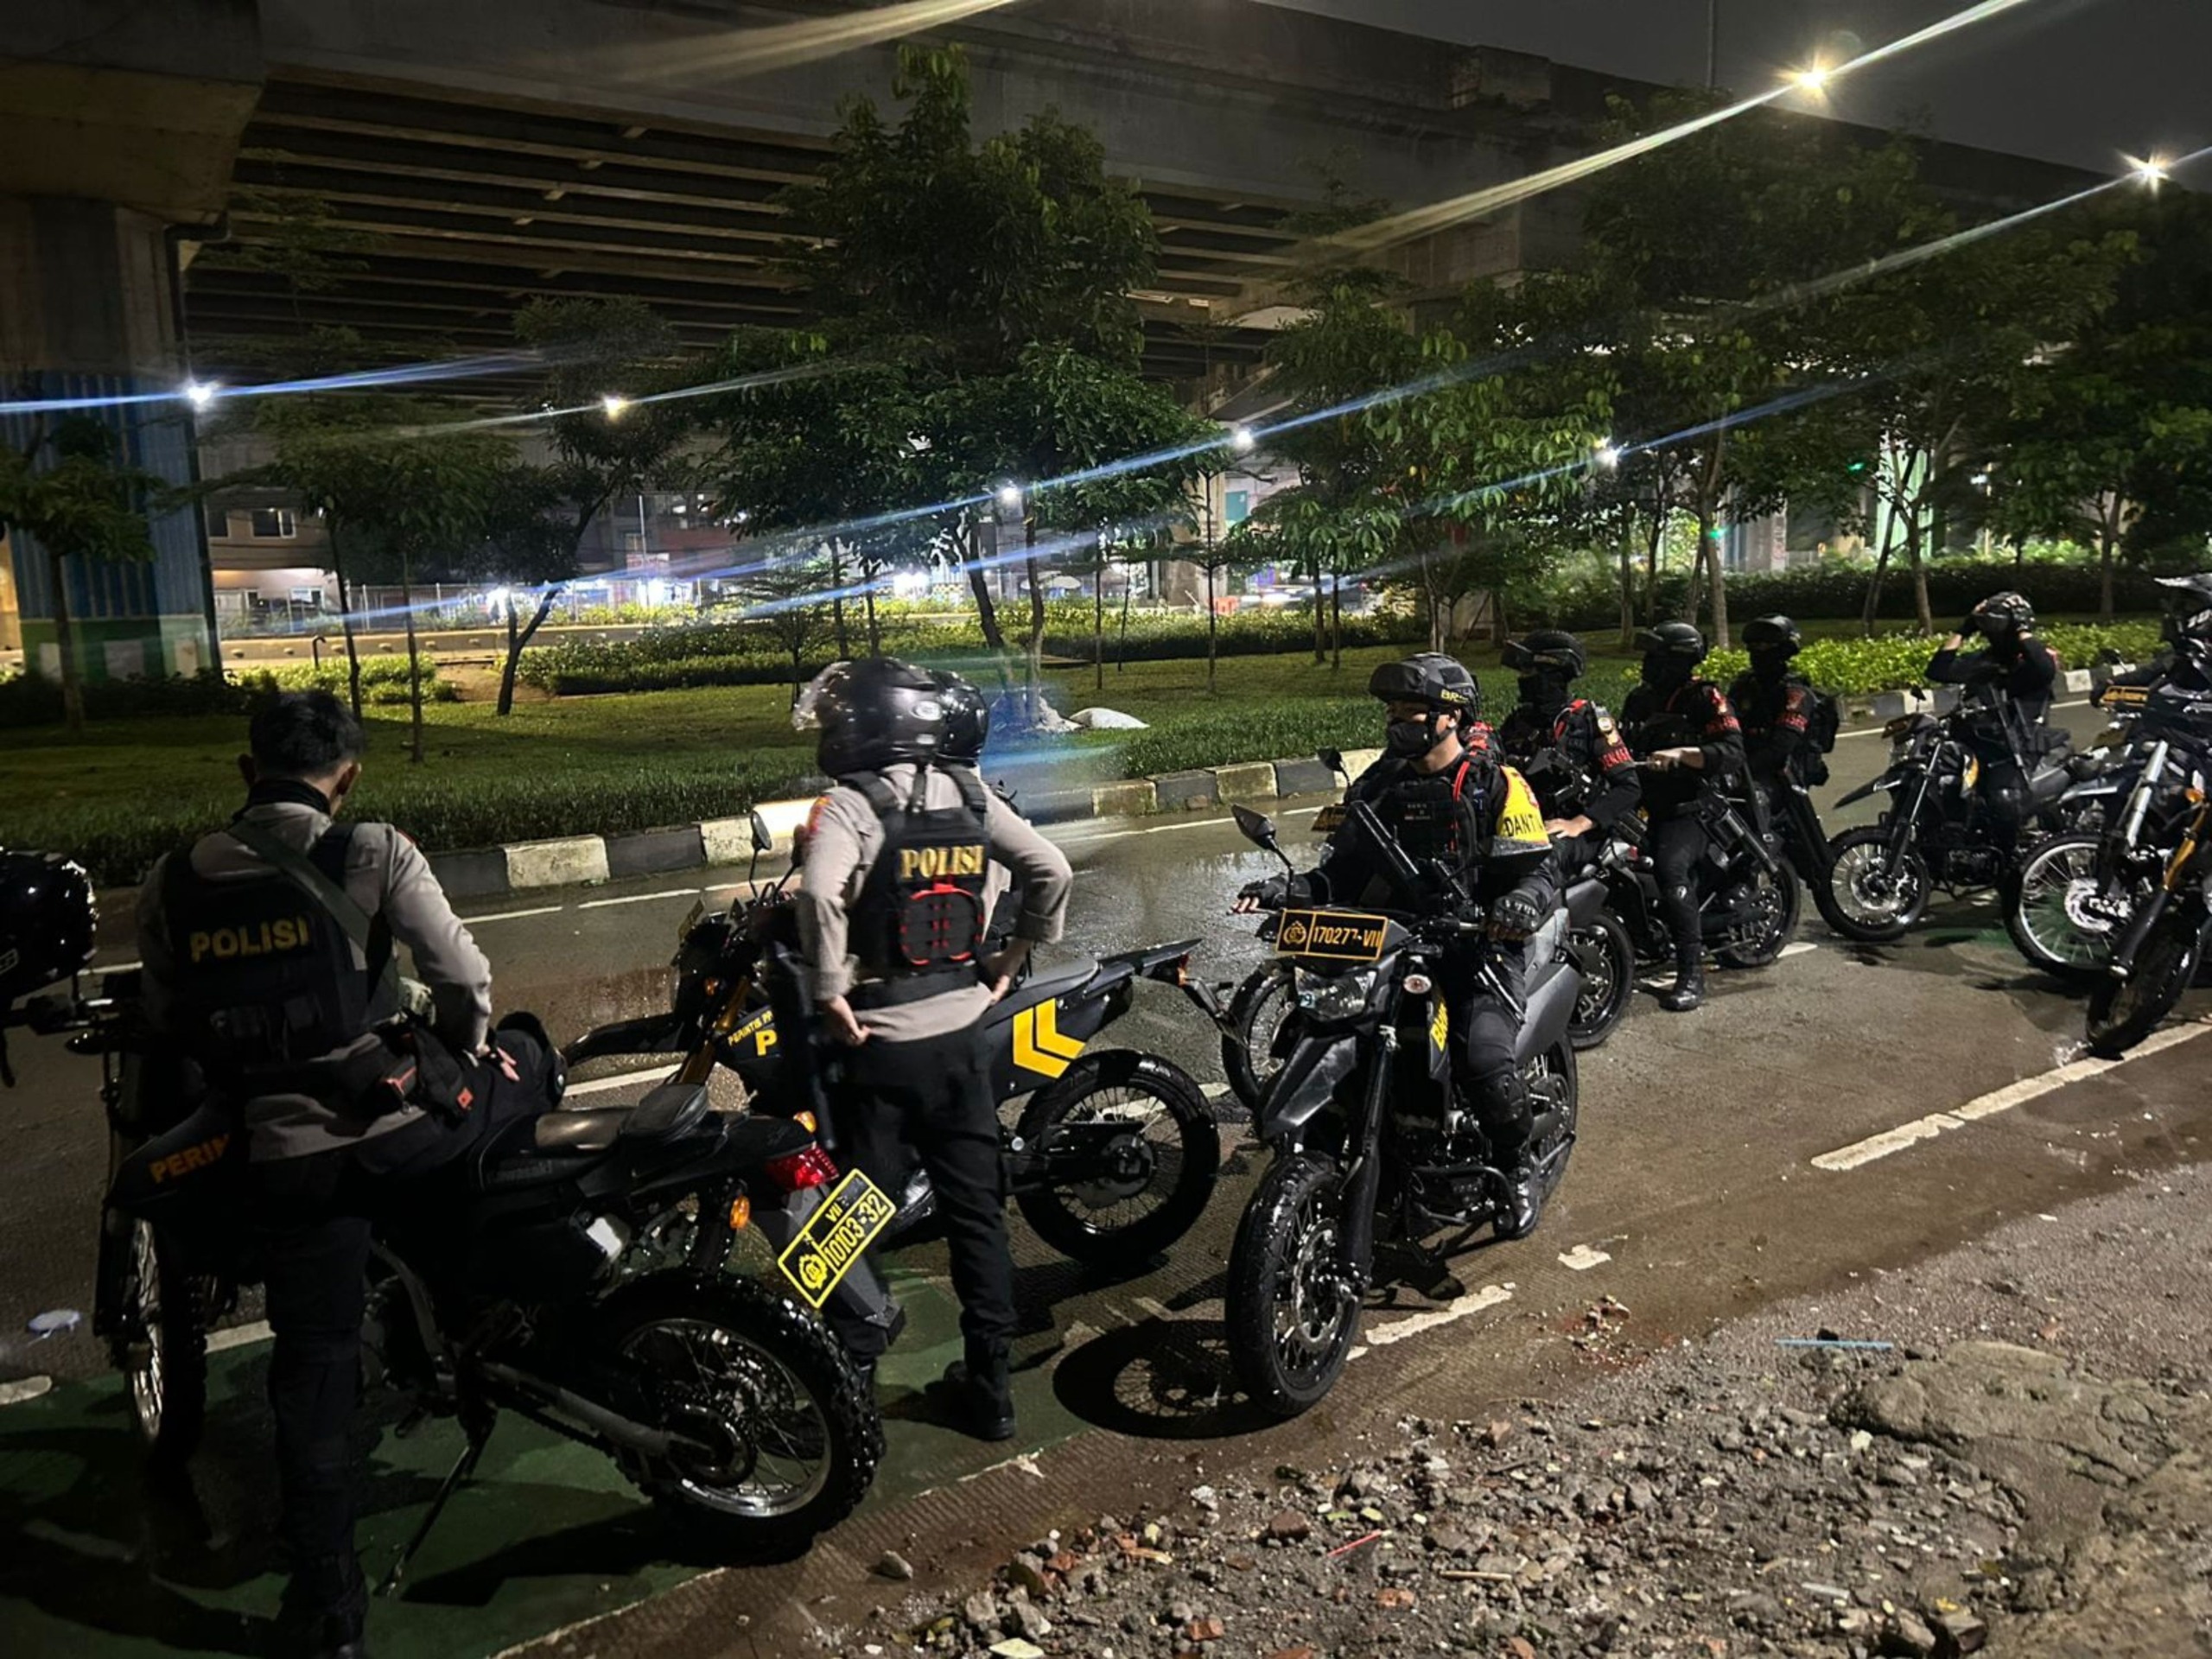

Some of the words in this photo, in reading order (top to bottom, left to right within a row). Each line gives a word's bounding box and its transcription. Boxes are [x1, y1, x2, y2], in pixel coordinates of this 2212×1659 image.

[899, 845, 983, 879] POLISI
[189, 916, 309, 963] POLISI
[825, 1202, 843, 1223] VII
